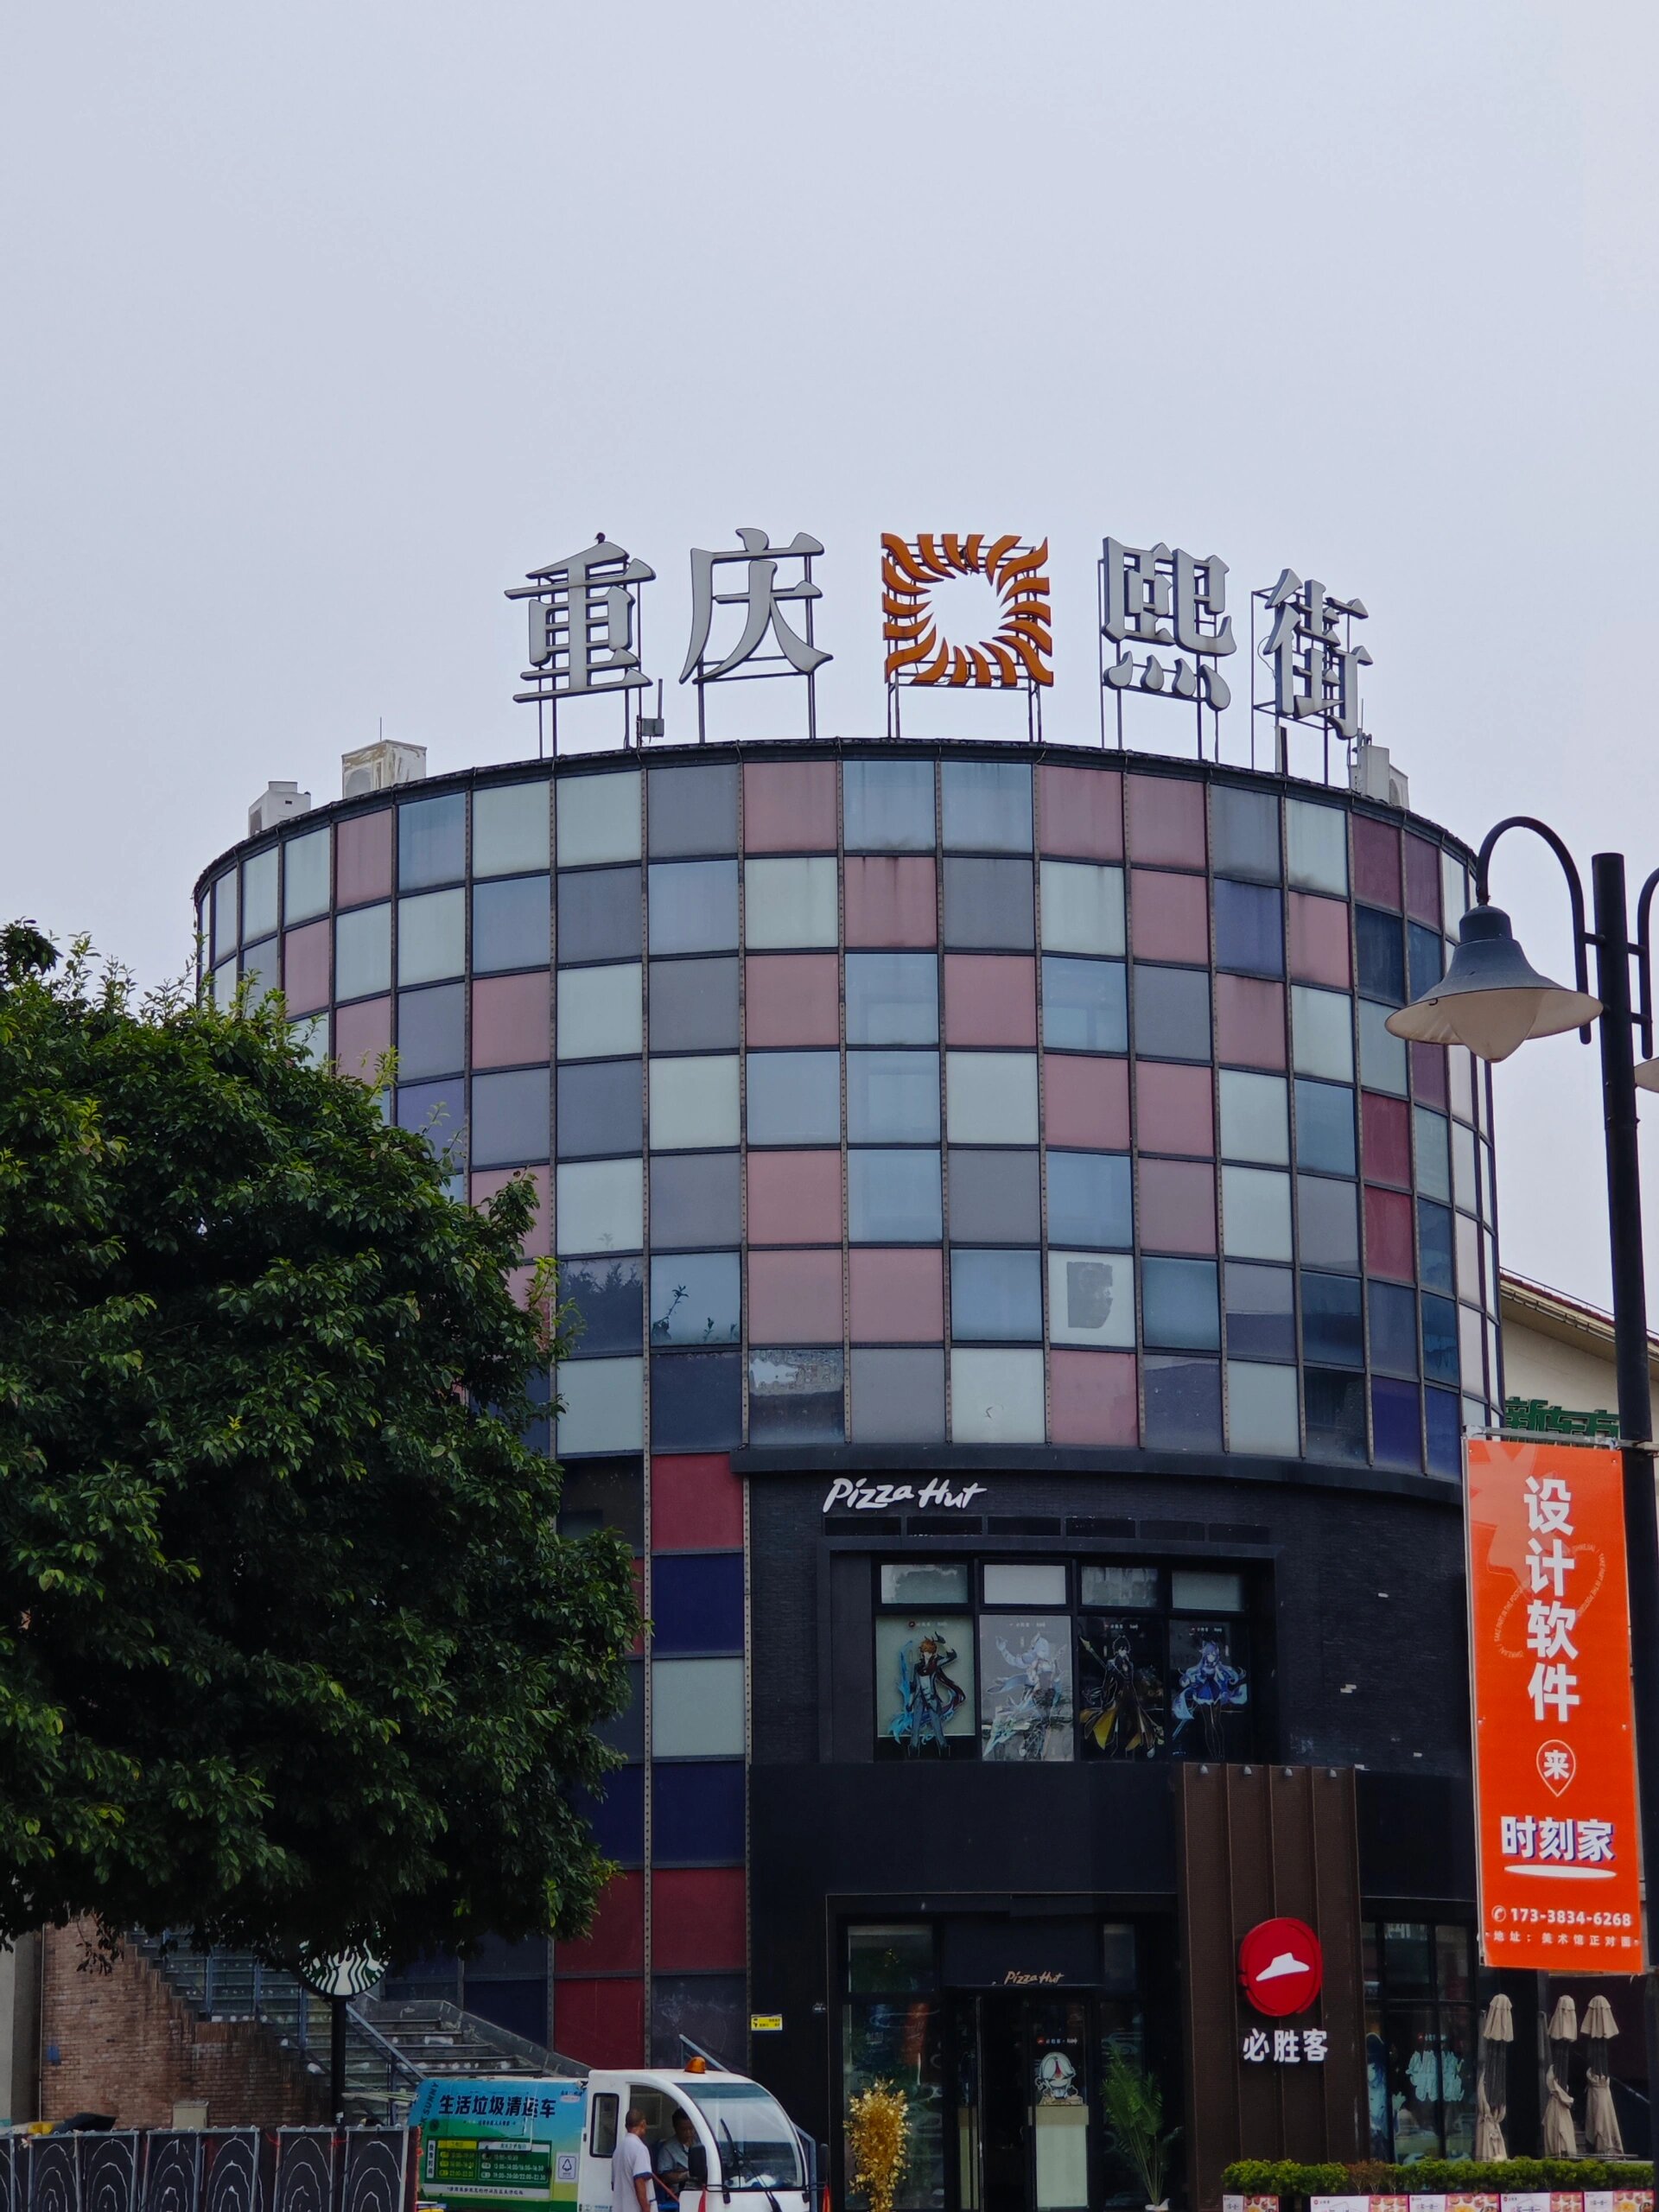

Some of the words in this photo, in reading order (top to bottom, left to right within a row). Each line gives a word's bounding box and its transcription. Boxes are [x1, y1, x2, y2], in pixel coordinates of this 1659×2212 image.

[504, 528, 833, 703] 重庆
[1103, 537, 1373, 740] 熙街
[823, 1478, 915, 1513] Pizza
[918, 1478, 988, 1509] Hut
[1523, 1477, 1581, 1724] 设计软件
[1543, 1749, 1571, 1779] 来
[1499, 1815, 1616, 1865] 时刻家
[1510, 1907, 1632, 1928] 173-3834-6268
[1003, 1971, 1039, 1986] Pizza
[1039, 1971, 1065, 1985] Hut
[1242, 2028, 1329, 2064] 必胜客
[423, 2082, 439, 2115] SUNNY
[438, 2094, 556, 2119] 生活垃圾清运车
